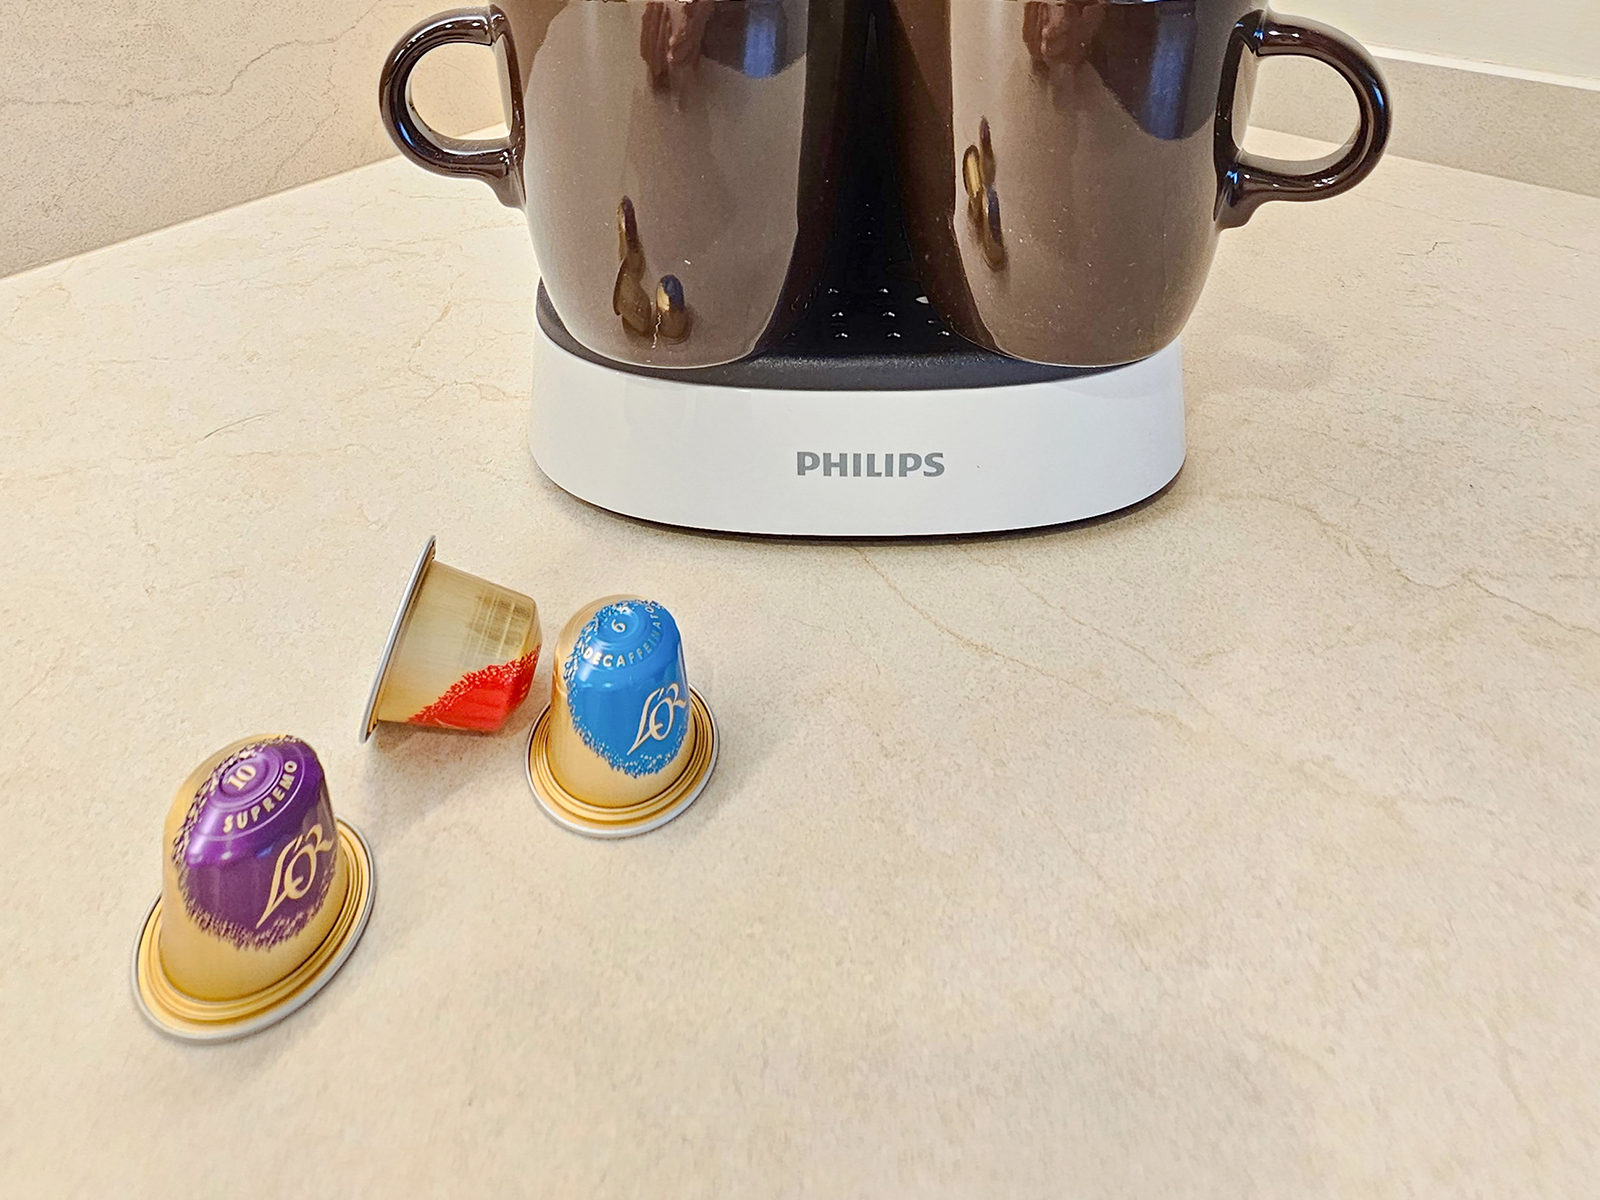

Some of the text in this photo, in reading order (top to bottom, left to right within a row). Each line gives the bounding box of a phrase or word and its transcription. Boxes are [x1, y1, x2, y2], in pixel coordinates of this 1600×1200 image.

[796, 451, 945, 478] PHILIPS
[583, 605, 661, 668] DECAFFEINATO
[611, 618, 626, 633] 6
[227, 764, 256, 791] 10
[222, 760, 298, 834] SUPREMO
